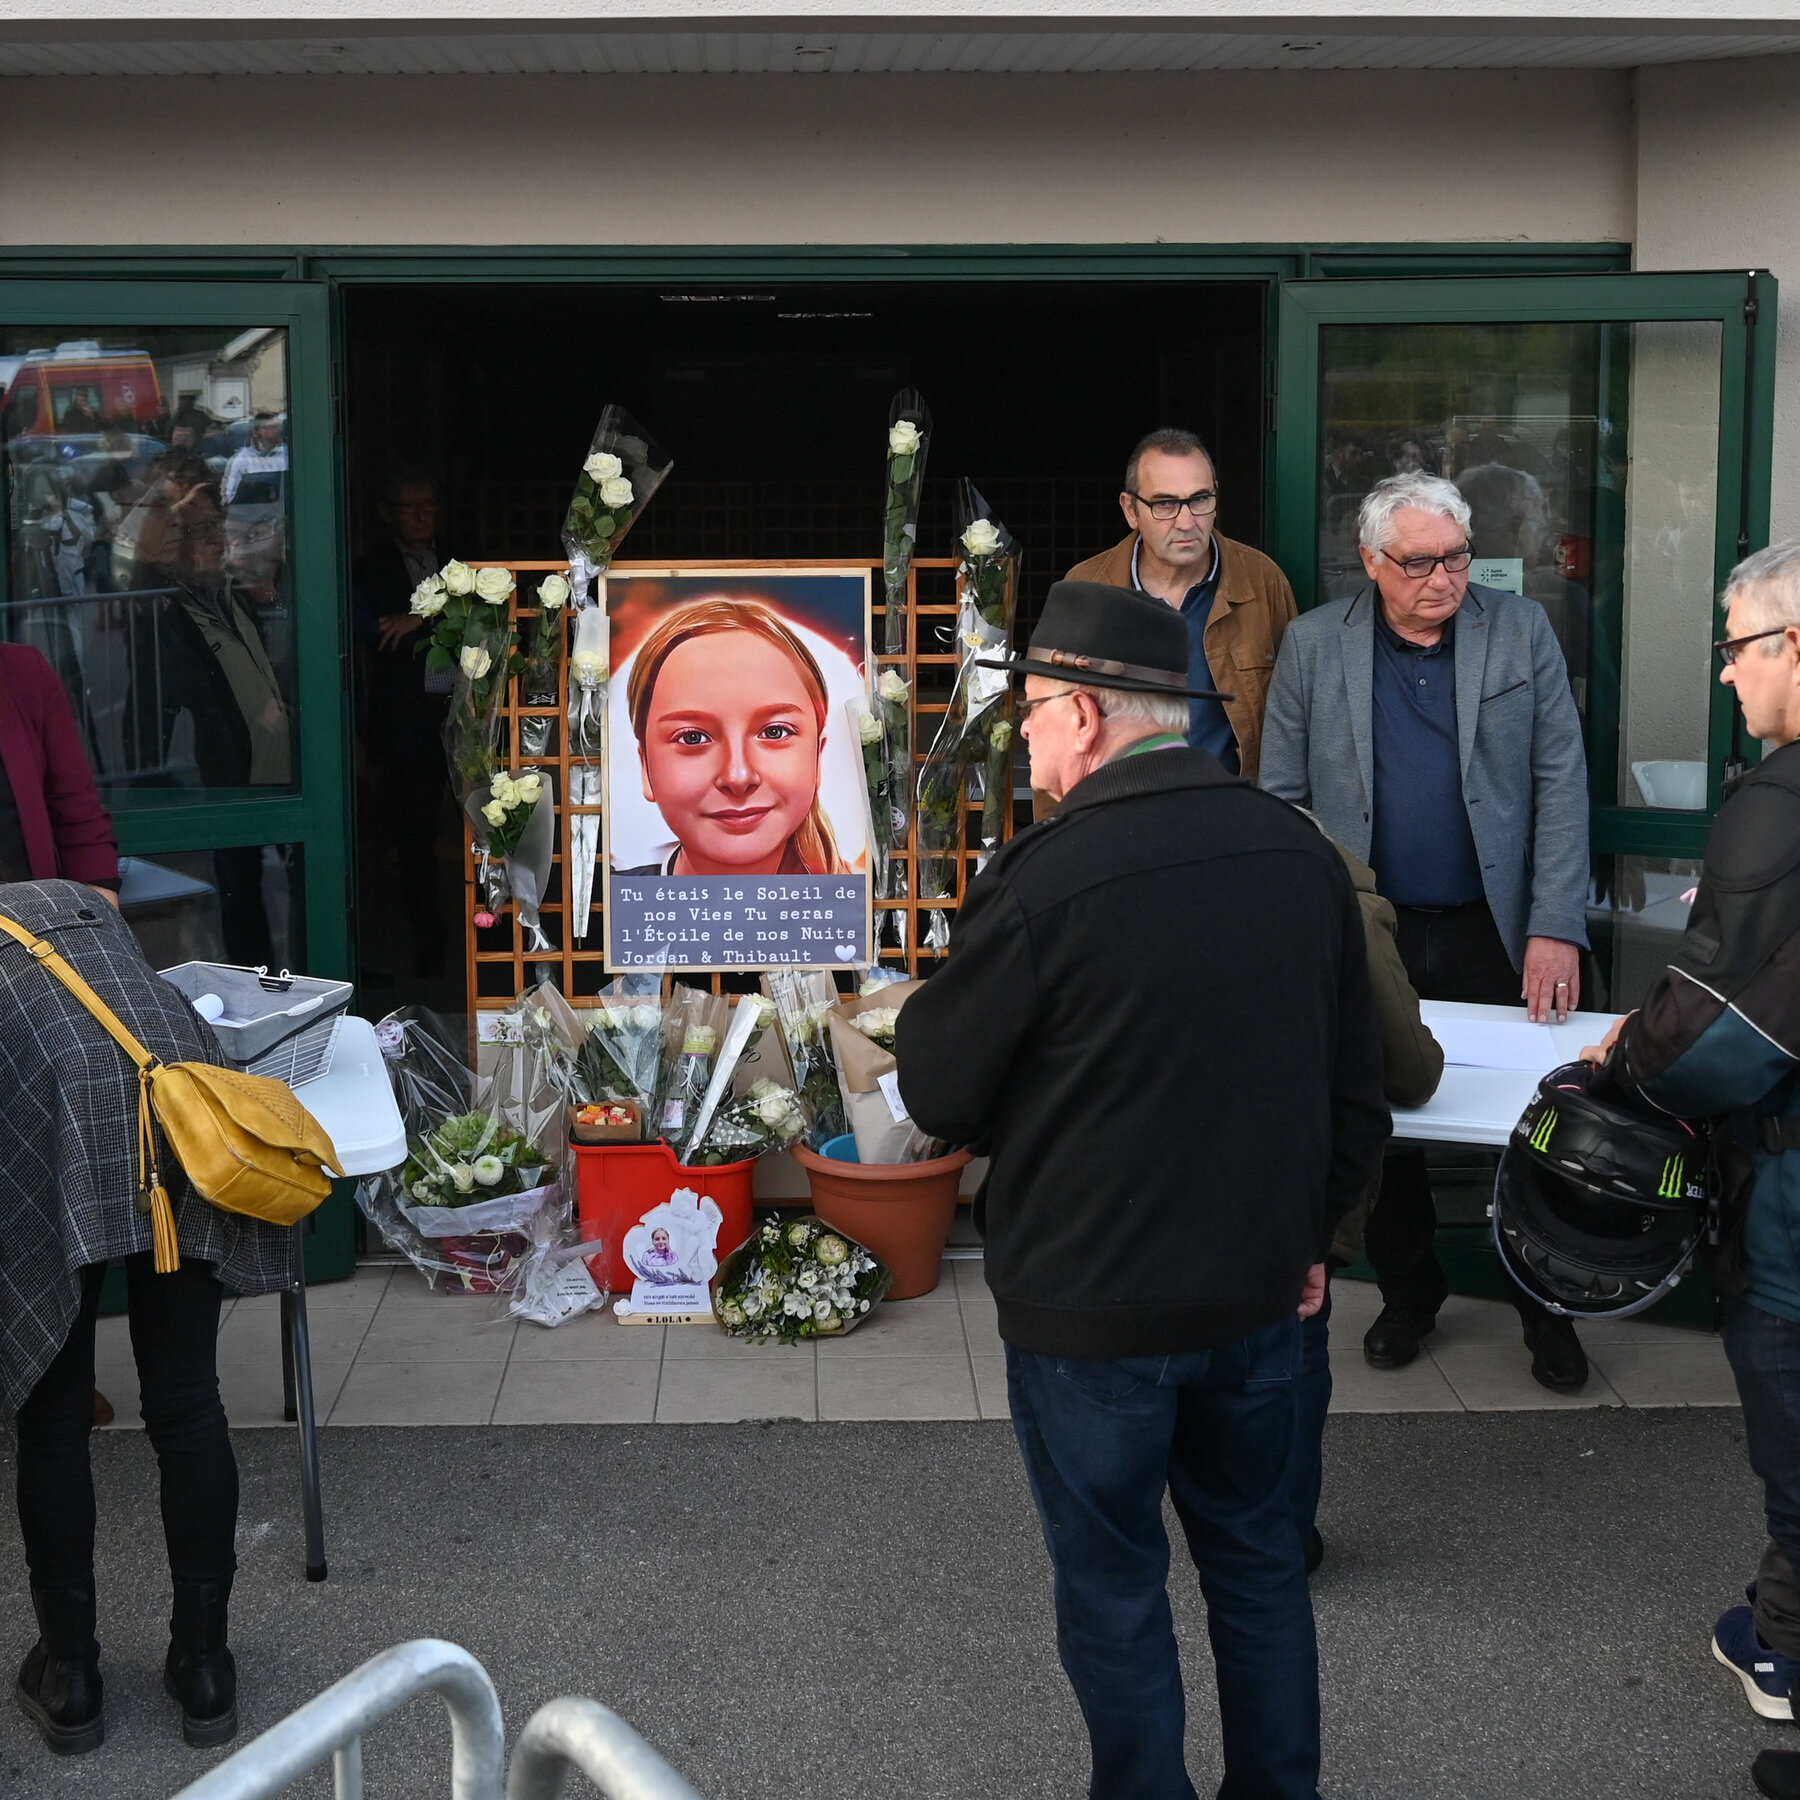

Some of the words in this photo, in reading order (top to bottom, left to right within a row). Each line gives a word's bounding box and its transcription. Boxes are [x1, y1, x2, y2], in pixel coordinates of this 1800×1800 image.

[620, 888, 644, 902] Tu
[723, 887, 744, 901] le
[757, 887, 823, 900] Soleil
[834, 886, 856, 899] de
[643, 911, 676, 922] nos
[688, 907, 733, 921] Vies
[744, 907, 768, 921] Tu
[779, 909, 834, 920] seras
[621, 924, 711, 942] l'Étoile
[723, 928, 744, 941] de
[756, 930, 789, 941] nos
[800, 926, 856, 940] Nuits
[621, 951, 690, 964] Jordan
[700, 950, 712, 963] &
[722, 949, 812, 963] Thibault
[655, 1315, 682, 1324] LOLA
